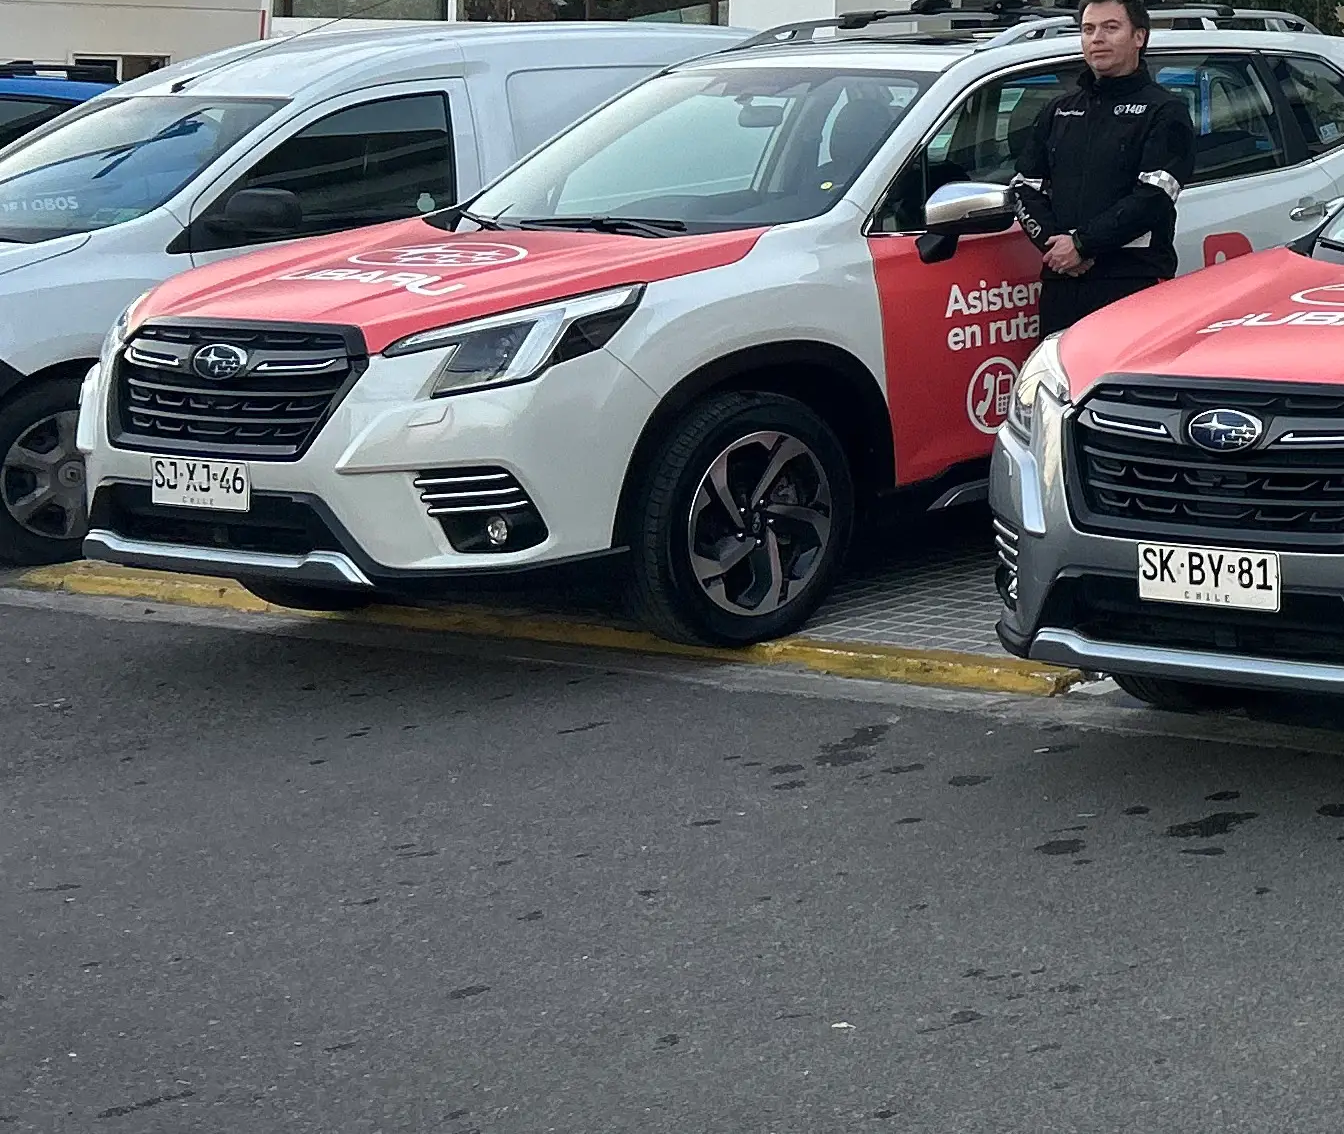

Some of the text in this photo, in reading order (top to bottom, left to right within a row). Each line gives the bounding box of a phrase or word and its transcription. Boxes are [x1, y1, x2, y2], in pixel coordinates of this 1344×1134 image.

[947, 311, 1040, 352] en ruta
[1184, 590, 1232, 604] CHILE
